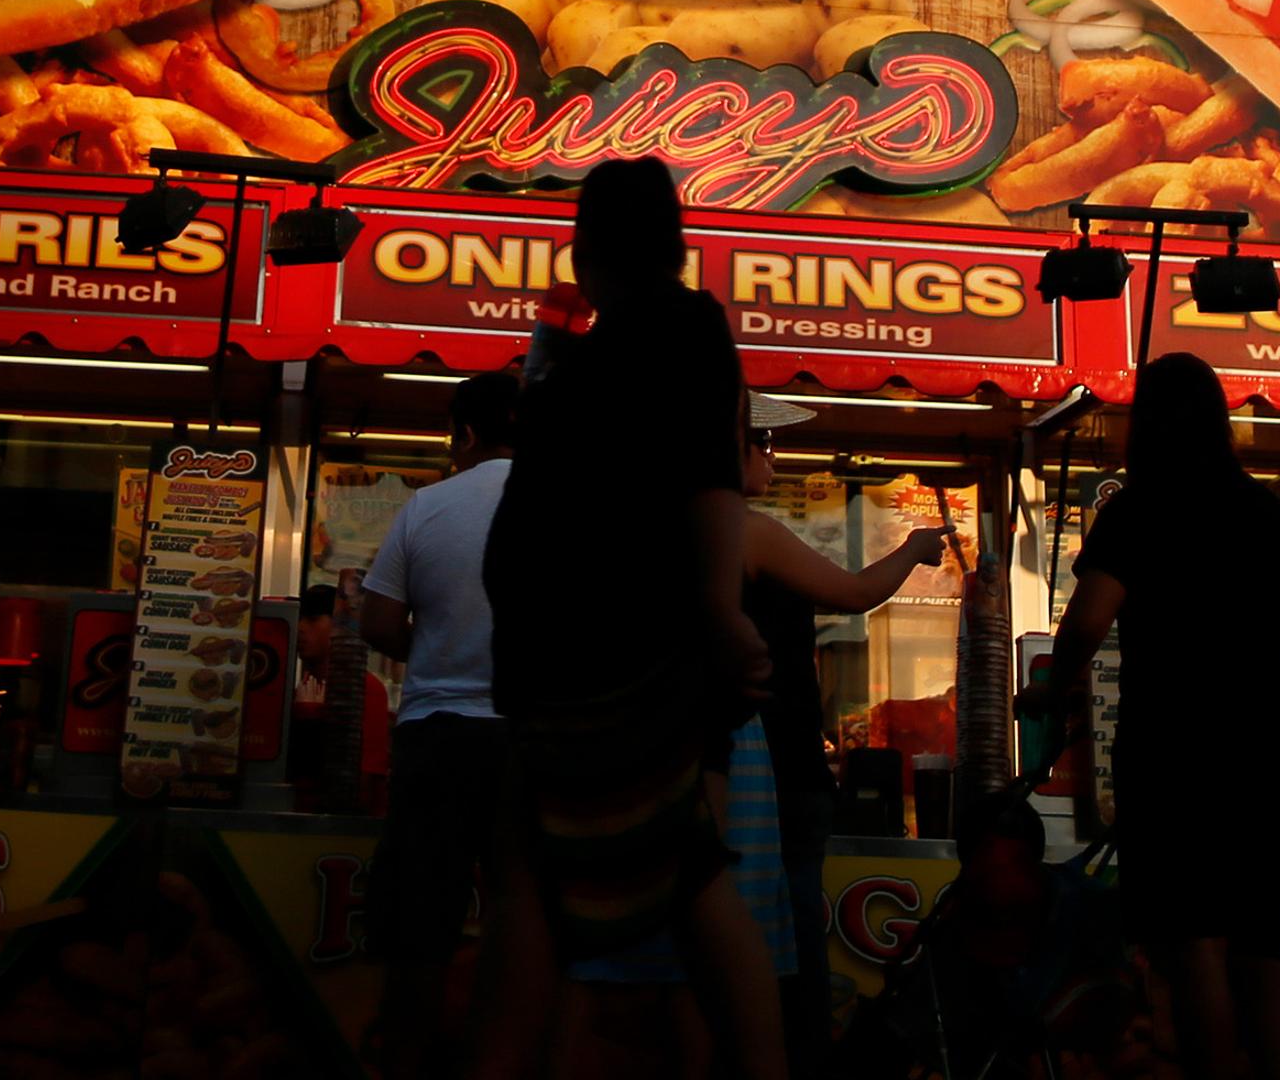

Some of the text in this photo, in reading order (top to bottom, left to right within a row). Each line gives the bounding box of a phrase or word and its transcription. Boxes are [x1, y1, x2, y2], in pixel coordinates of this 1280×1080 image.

[50, 275, 178, 304] Ranch
[730, 252, 1026, 318] RINGS
[468, 298, 540, 320] wit
[740, 311, 933, 347] Dressing
[901, 504, 963, 521] POPULR!
